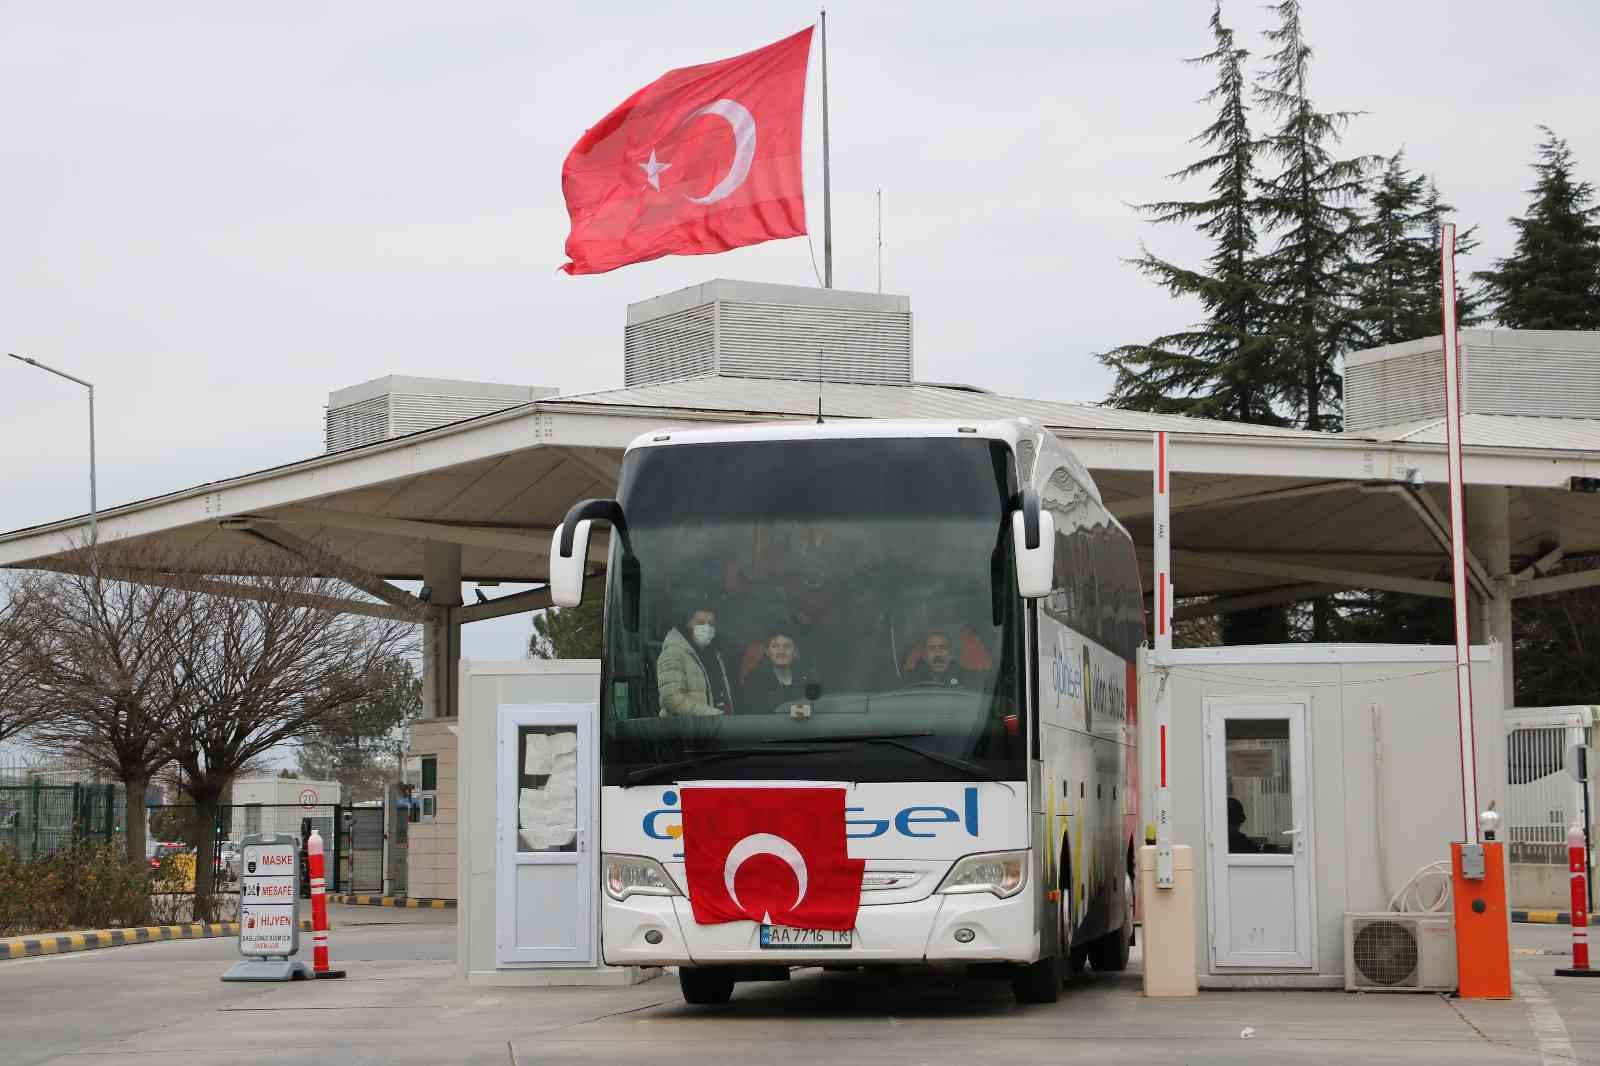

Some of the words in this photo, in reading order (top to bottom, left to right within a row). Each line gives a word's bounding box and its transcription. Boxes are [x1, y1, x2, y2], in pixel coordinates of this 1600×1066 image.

[262, 855, 293, 865] MASKE
[261, 886, 293, 896] MESAFE
[771, 928, 790, 942] AA
[793, 928, 824, 942] 7716
